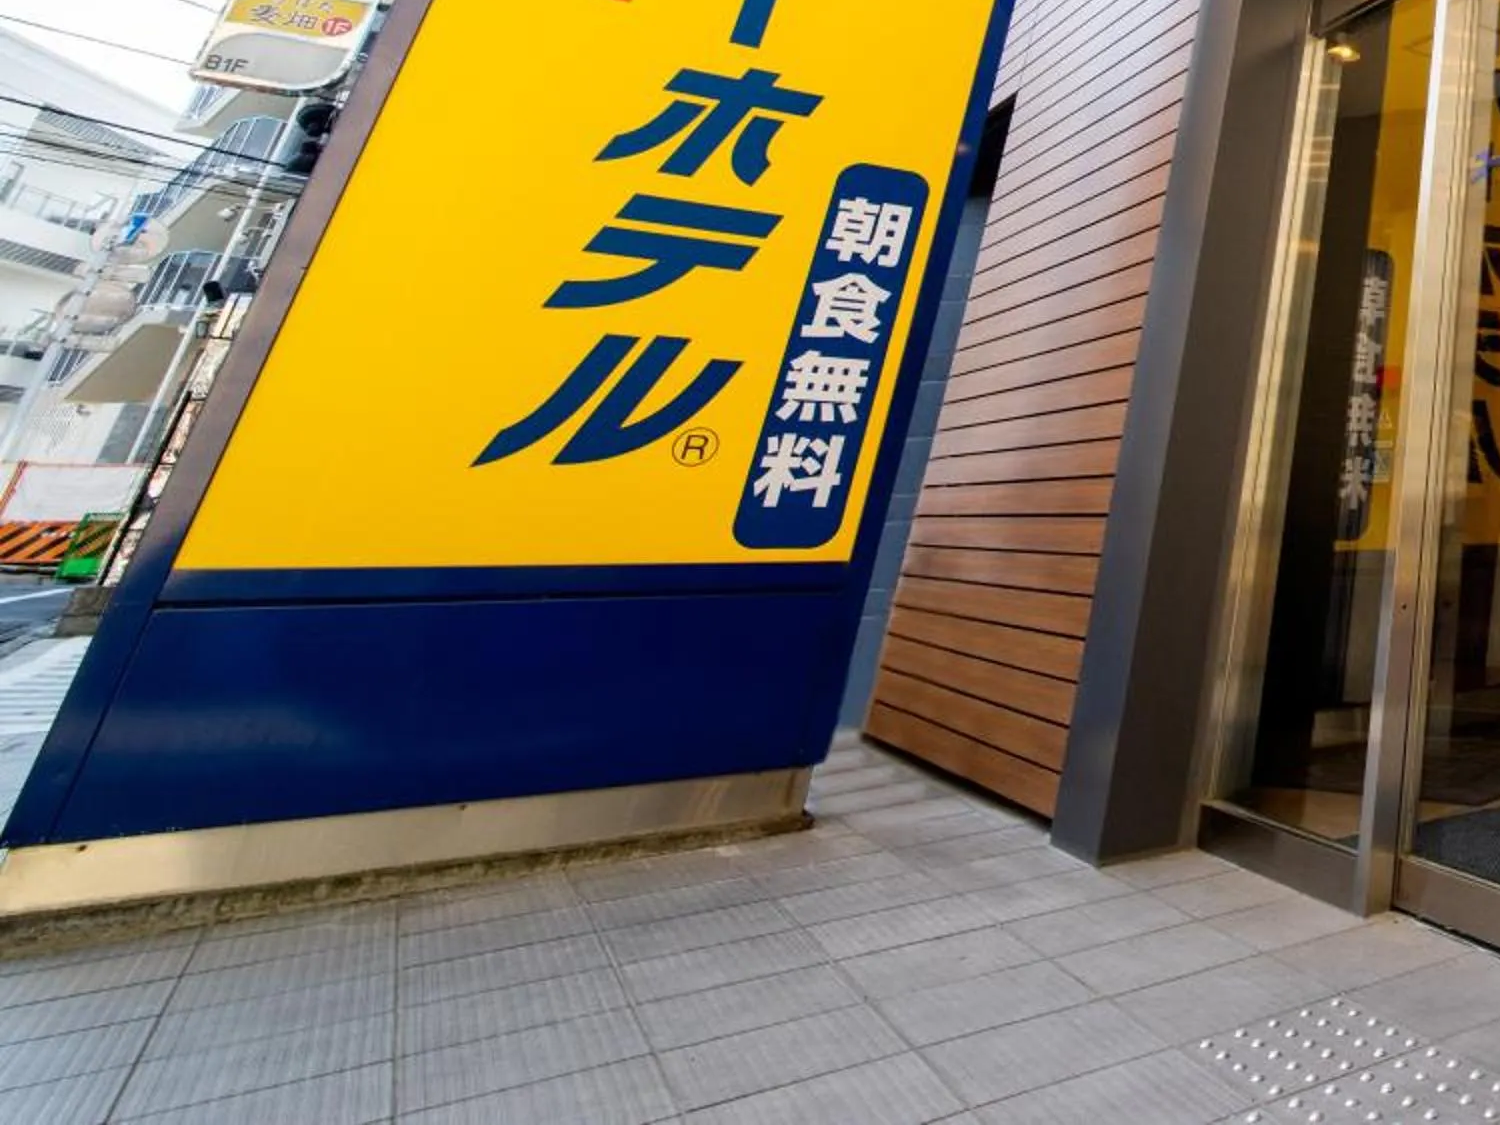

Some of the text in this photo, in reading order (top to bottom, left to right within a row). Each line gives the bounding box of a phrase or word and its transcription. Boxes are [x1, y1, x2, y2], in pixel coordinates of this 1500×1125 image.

[205, 54, 249, 73] B1F
[754, 197, 914, 509] 朝食無料
